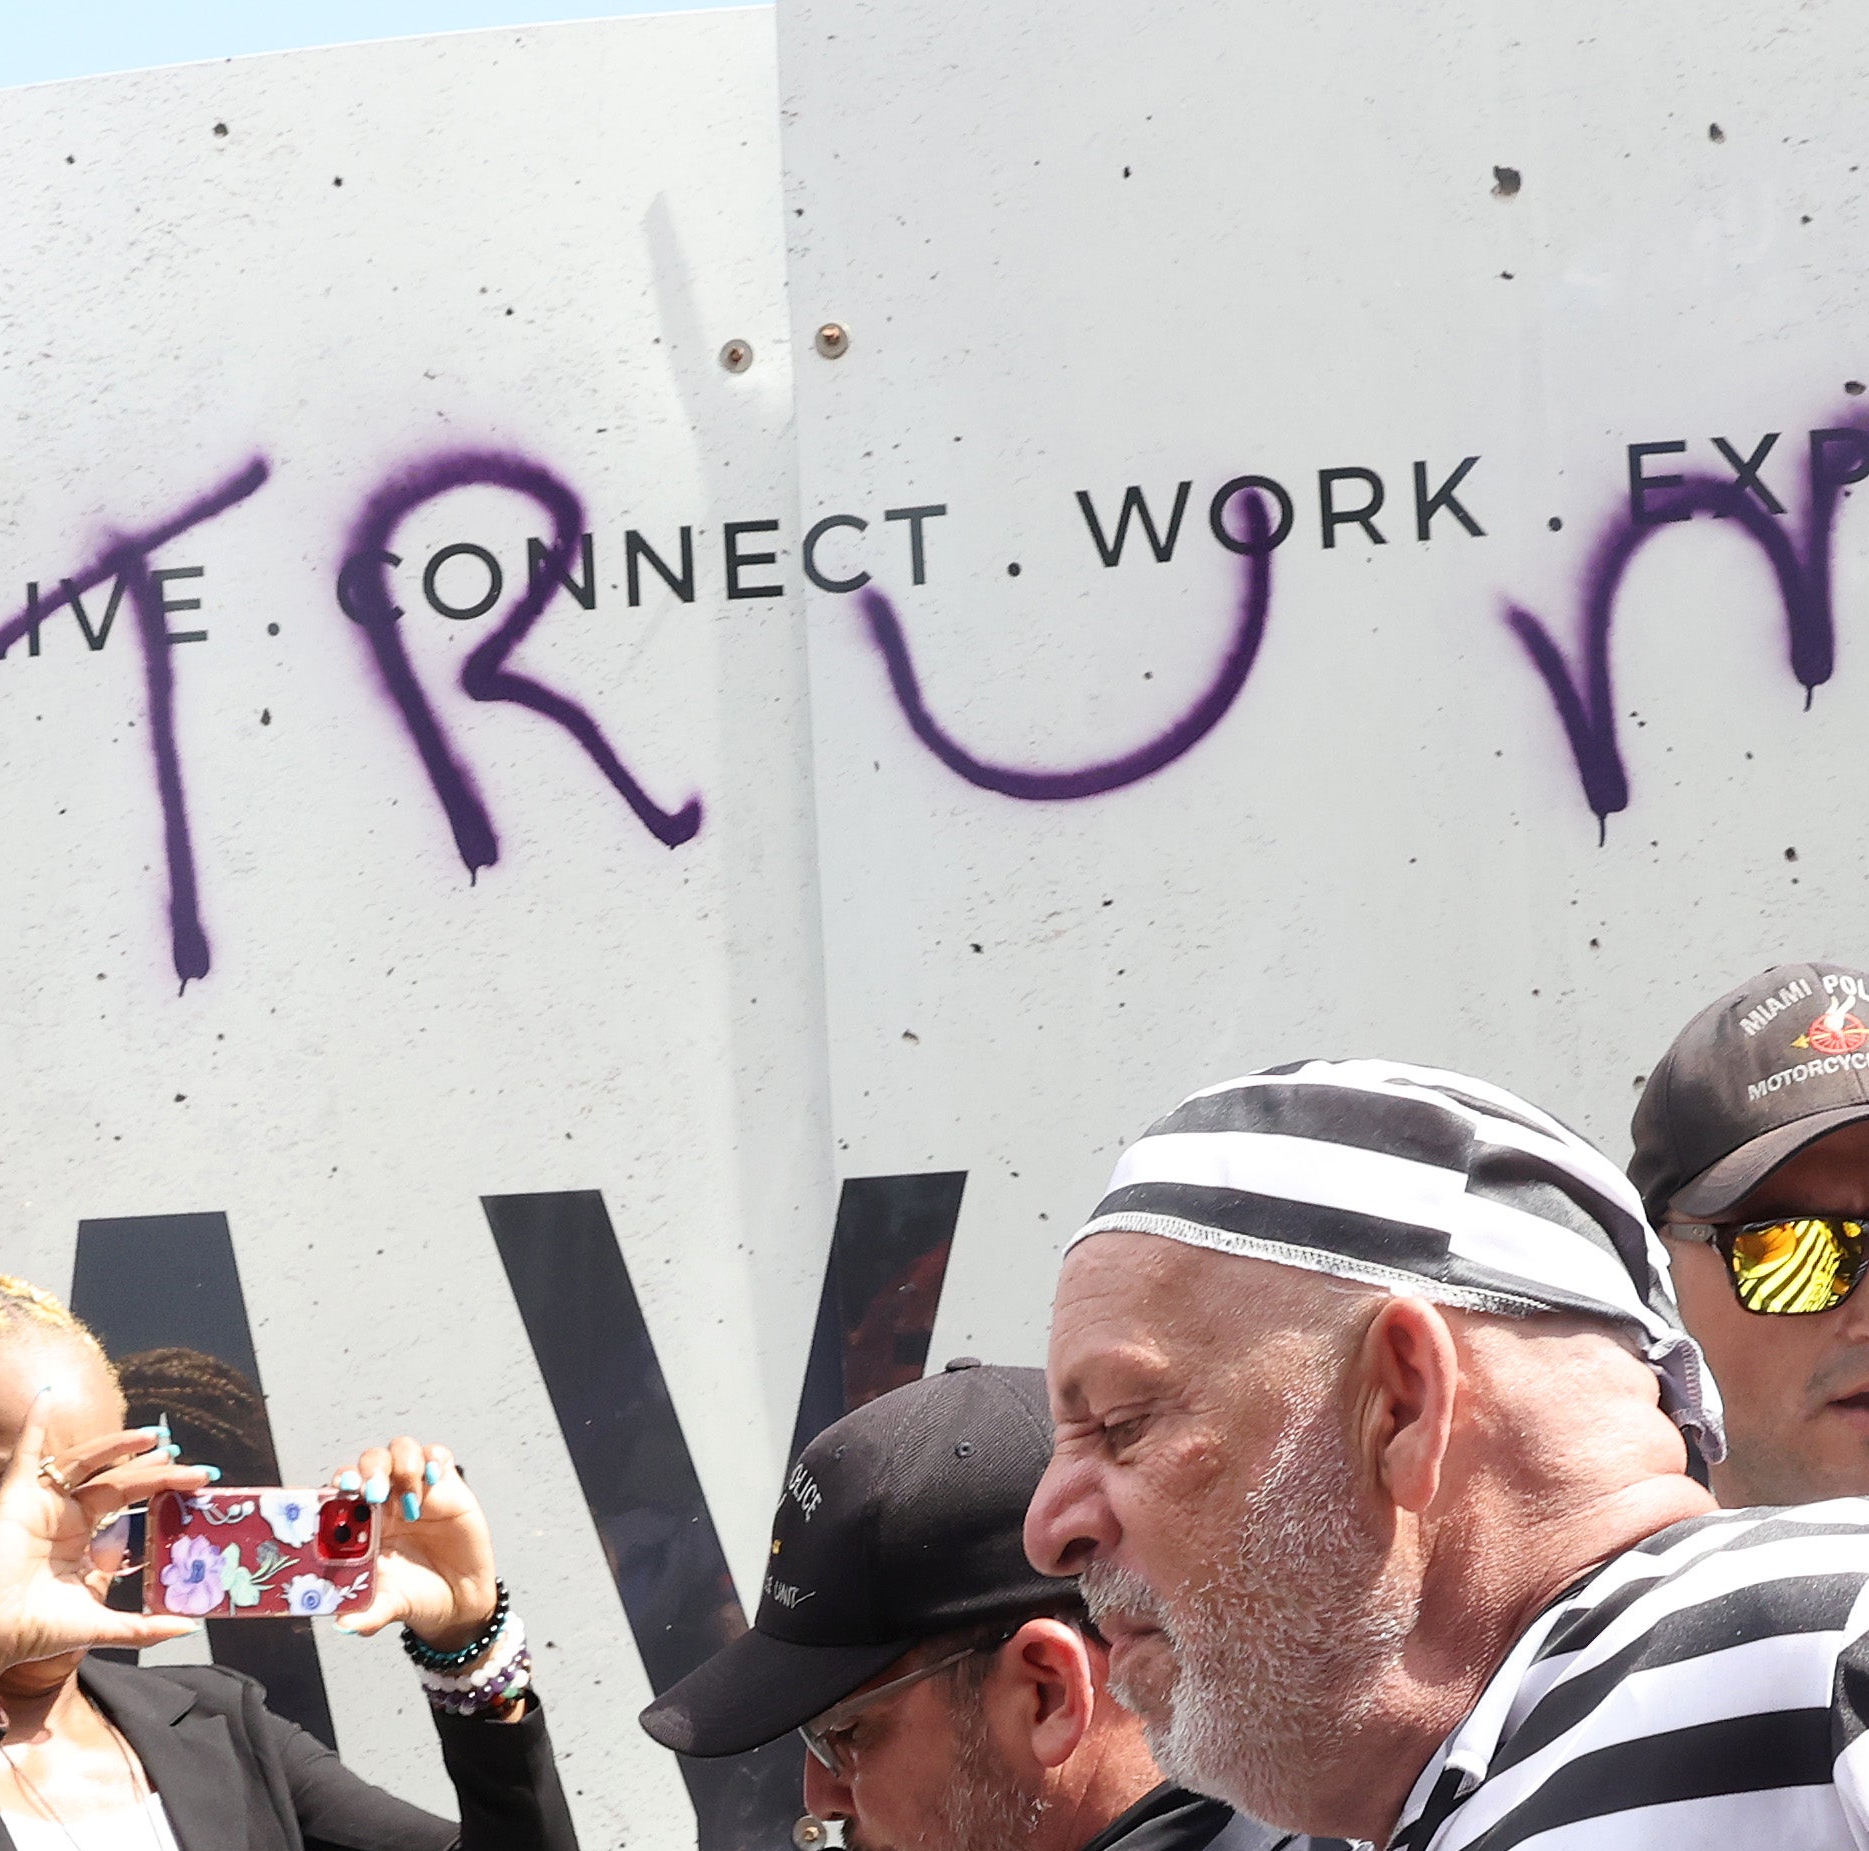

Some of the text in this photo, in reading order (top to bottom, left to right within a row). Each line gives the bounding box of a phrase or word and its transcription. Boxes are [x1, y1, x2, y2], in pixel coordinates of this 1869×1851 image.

[338, 503, 950, 626] CONNECT
[1077, 456, 1487, 570] WORK
[1738, 977, 1812, 1038] MIAMI
